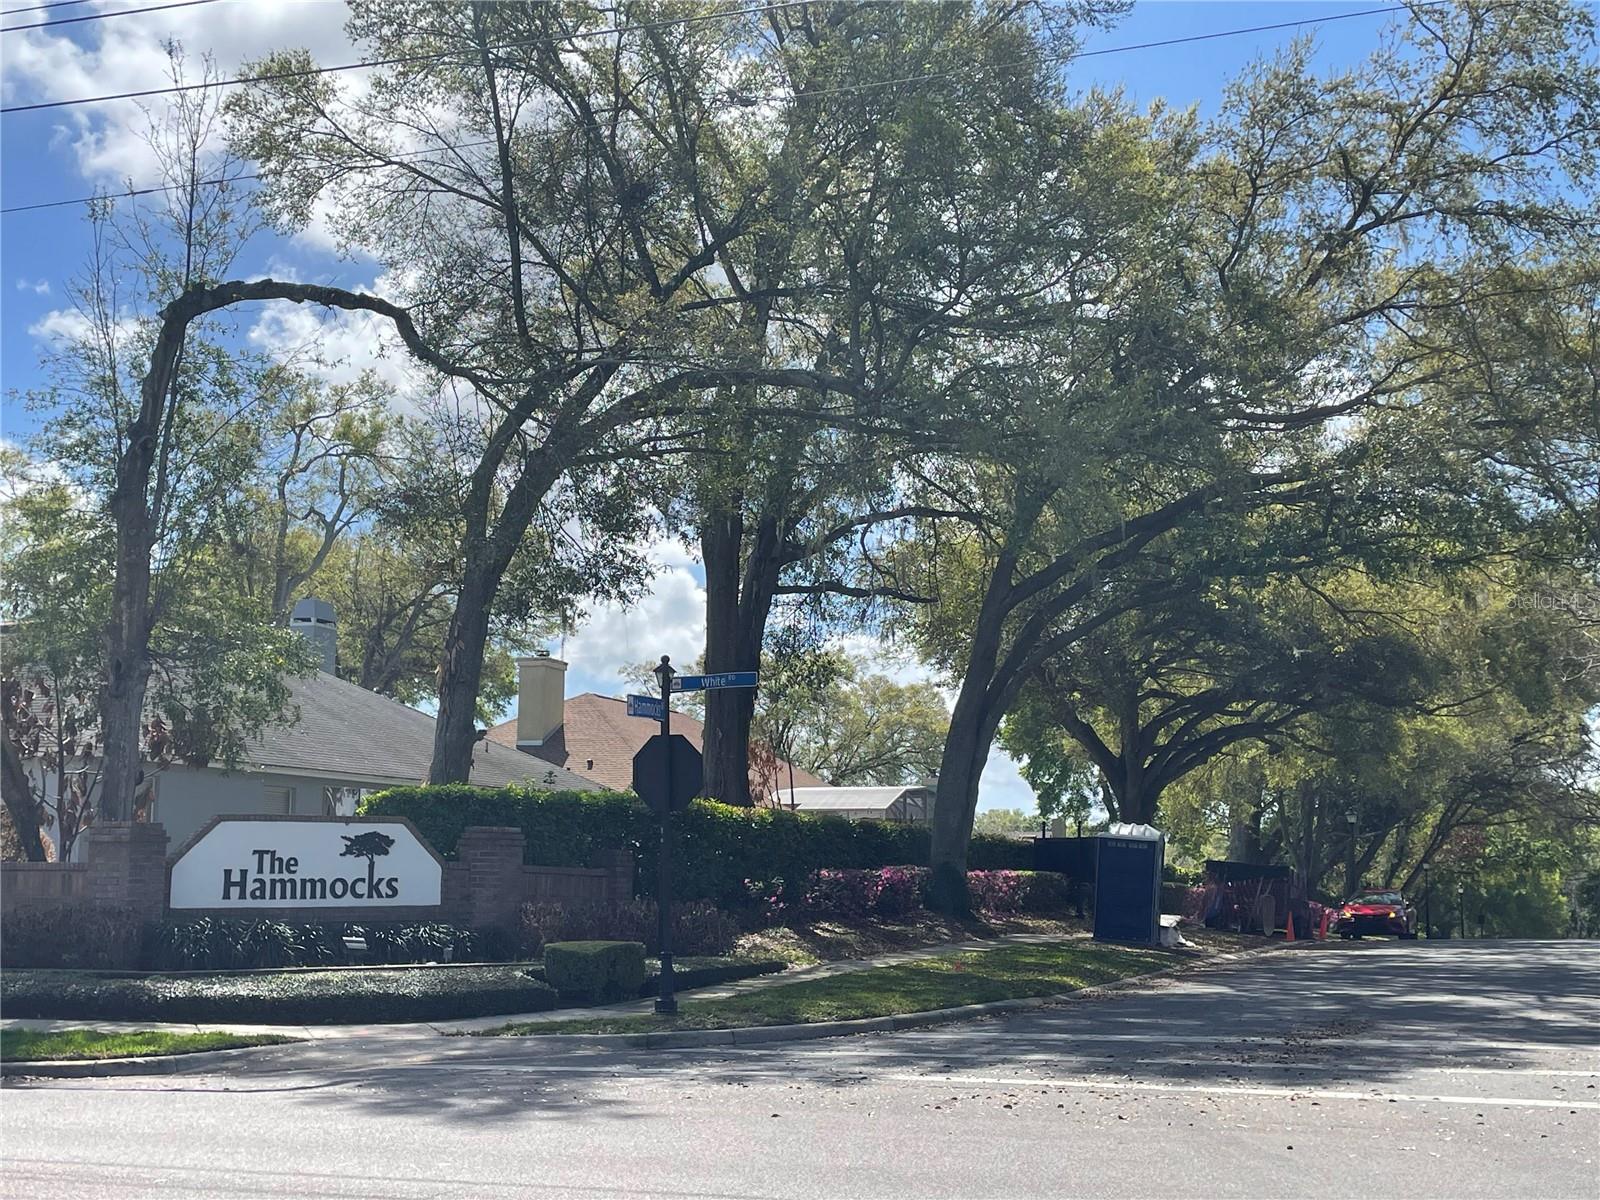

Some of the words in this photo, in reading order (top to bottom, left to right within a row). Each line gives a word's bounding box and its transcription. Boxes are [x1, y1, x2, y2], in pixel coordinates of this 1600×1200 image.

[701, 676, 726, 687] White
[252, 849, 299, 875] The
[222, 868, 399, 901] Hammocks
